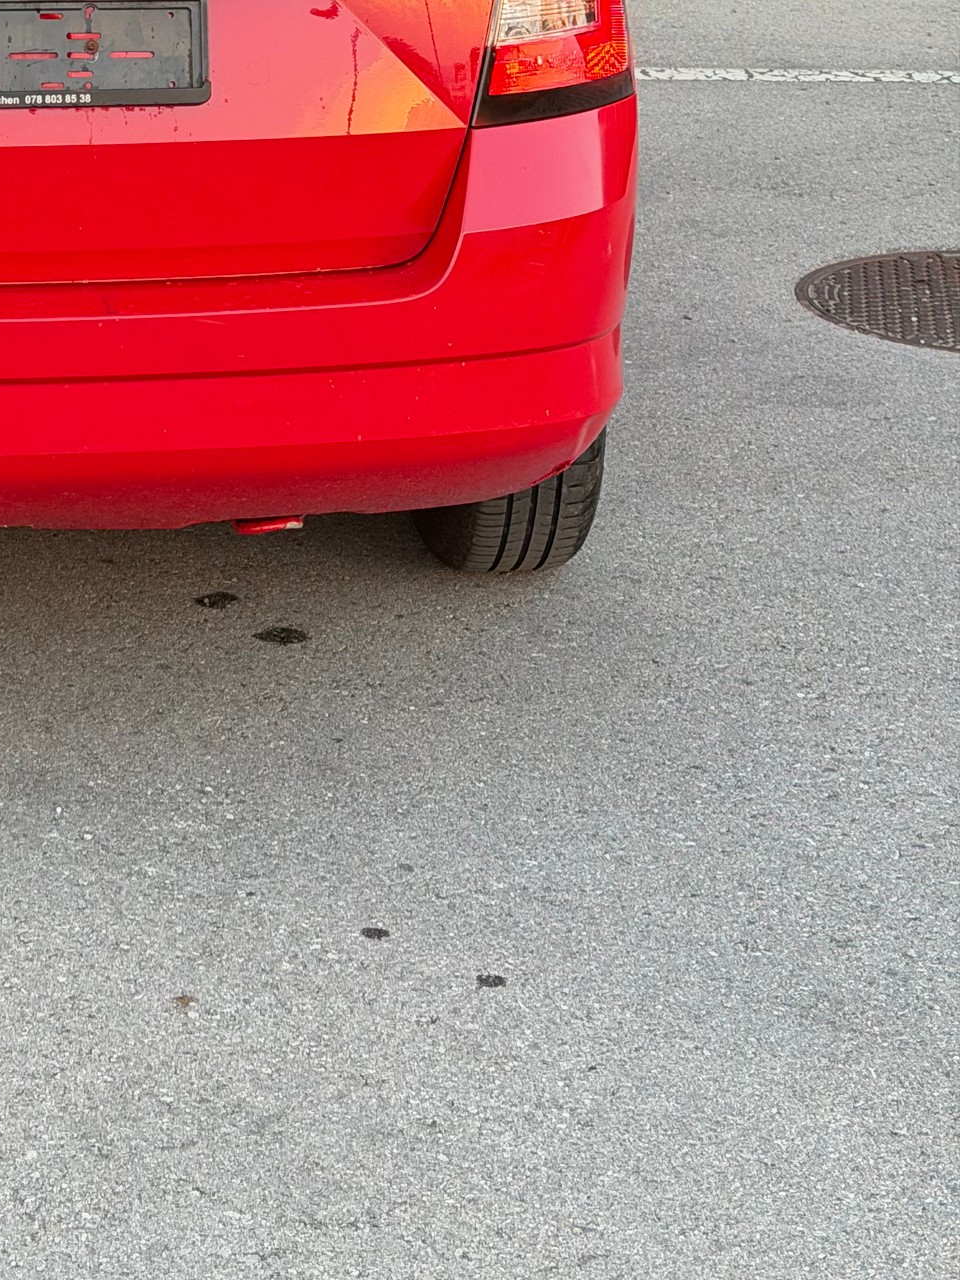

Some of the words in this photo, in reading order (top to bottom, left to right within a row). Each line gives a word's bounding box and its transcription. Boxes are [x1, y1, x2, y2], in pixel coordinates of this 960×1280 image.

[24, 94, 42, 105] 078
[44, 94, 63, 104] 803
[65, 94, 78, 104] 85
[79, 93, 92, 104] 38
